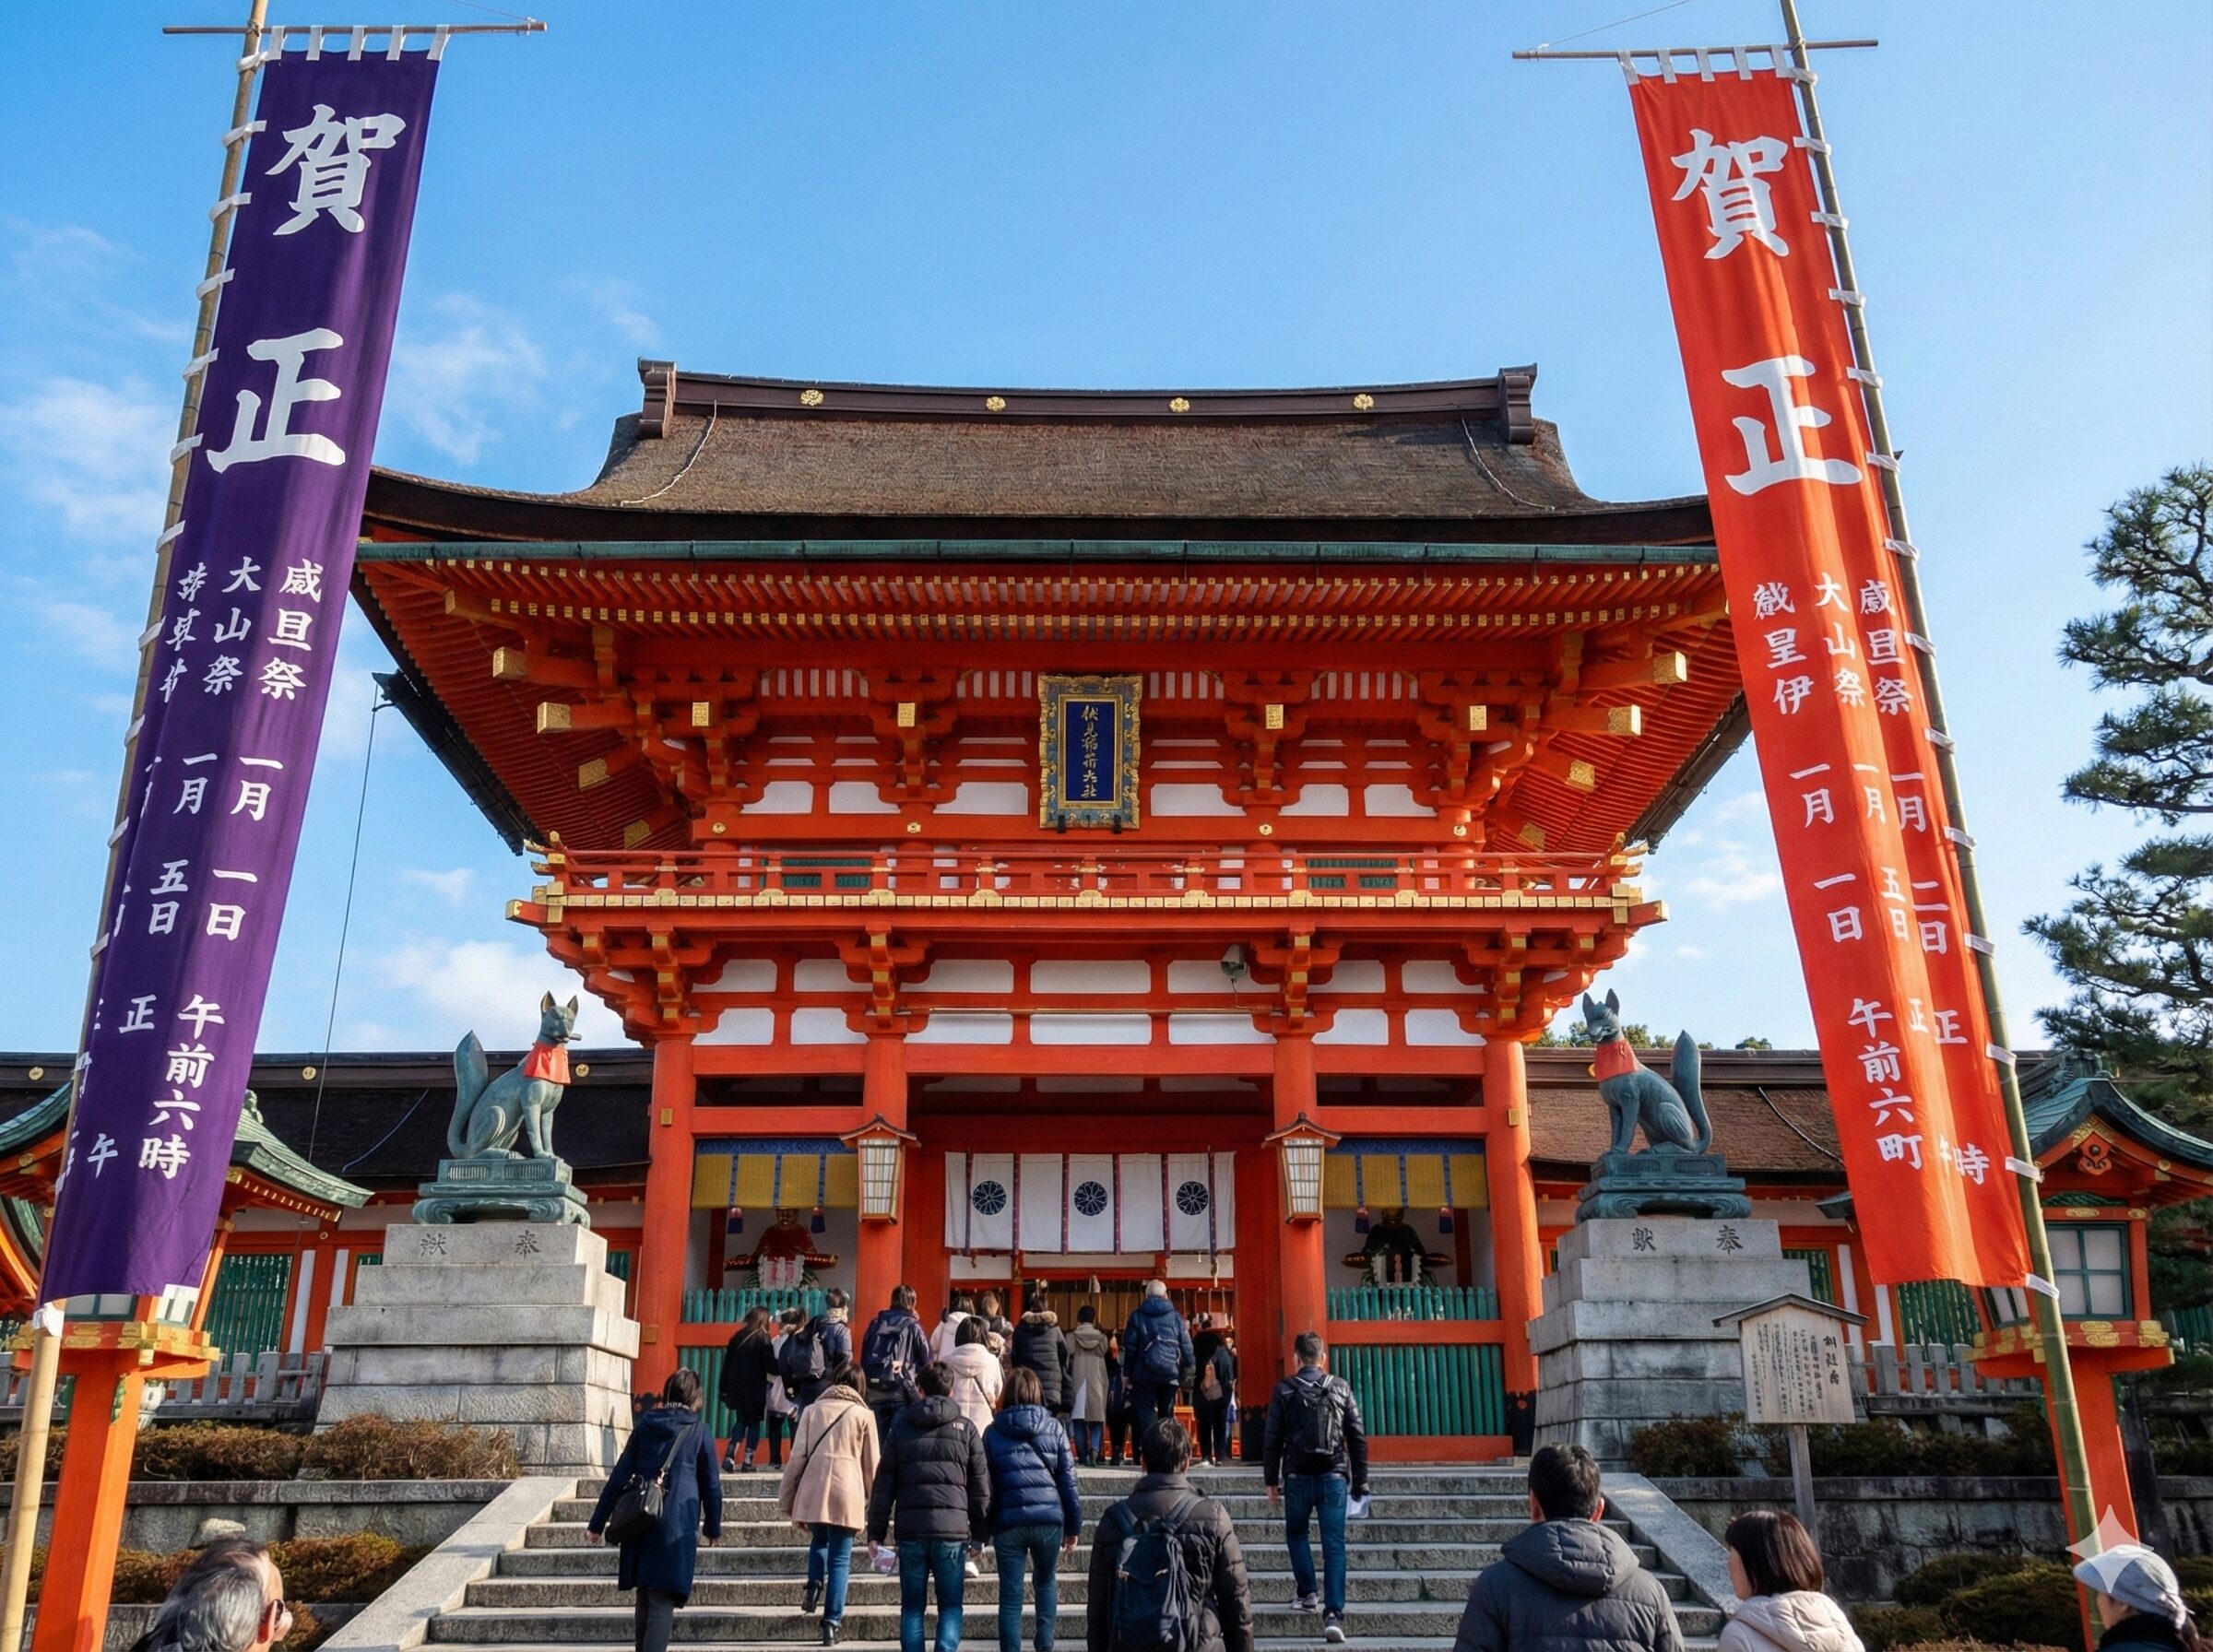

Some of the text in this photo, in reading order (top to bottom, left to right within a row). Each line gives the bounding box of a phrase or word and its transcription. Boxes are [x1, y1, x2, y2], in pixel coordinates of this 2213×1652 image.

[207, 104, 406, 473] 賀正
[1671, 128, 1864, 495] 賀正
[203, 557, 261, 694] 大山祭
[1814, 572, 1866, 707] 大山祭
[139, 995, 224, 1179] 午前六時
[1848, 998, 1923, 1170] 午前六町
